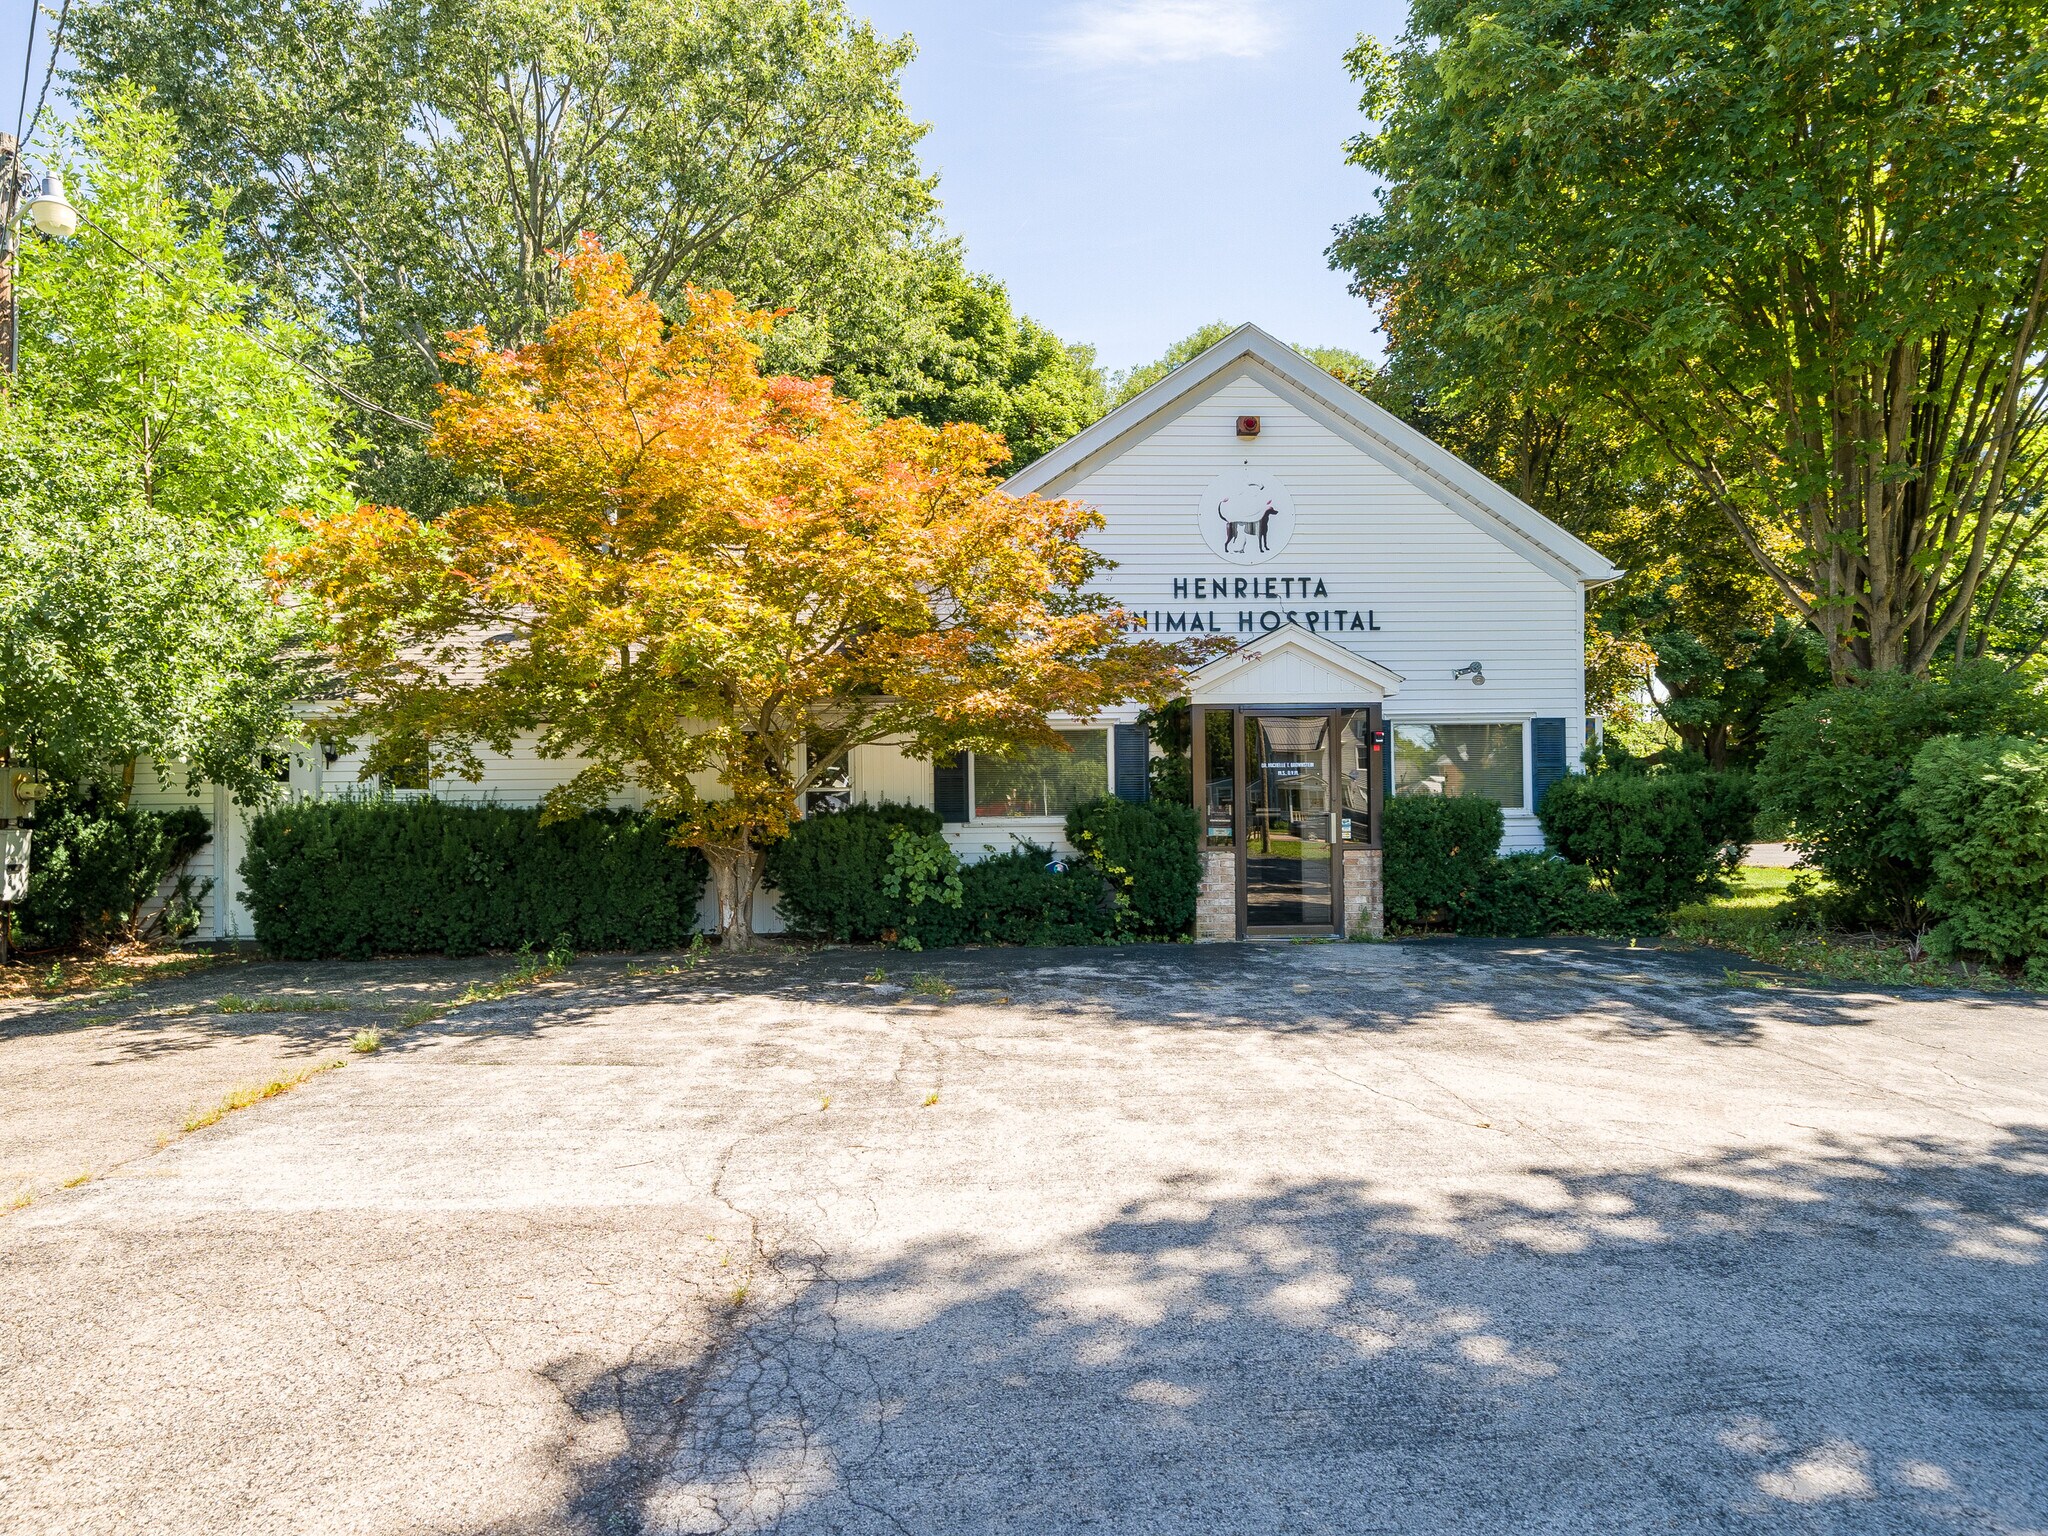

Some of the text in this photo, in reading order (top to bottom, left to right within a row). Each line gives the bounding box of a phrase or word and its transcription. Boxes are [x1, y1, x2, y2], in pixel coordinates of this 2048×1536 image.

[1173, 577, 1328, 599] HENRIETTA
[1117, 610, 1381, 632] NIMAL HOSPITAL
